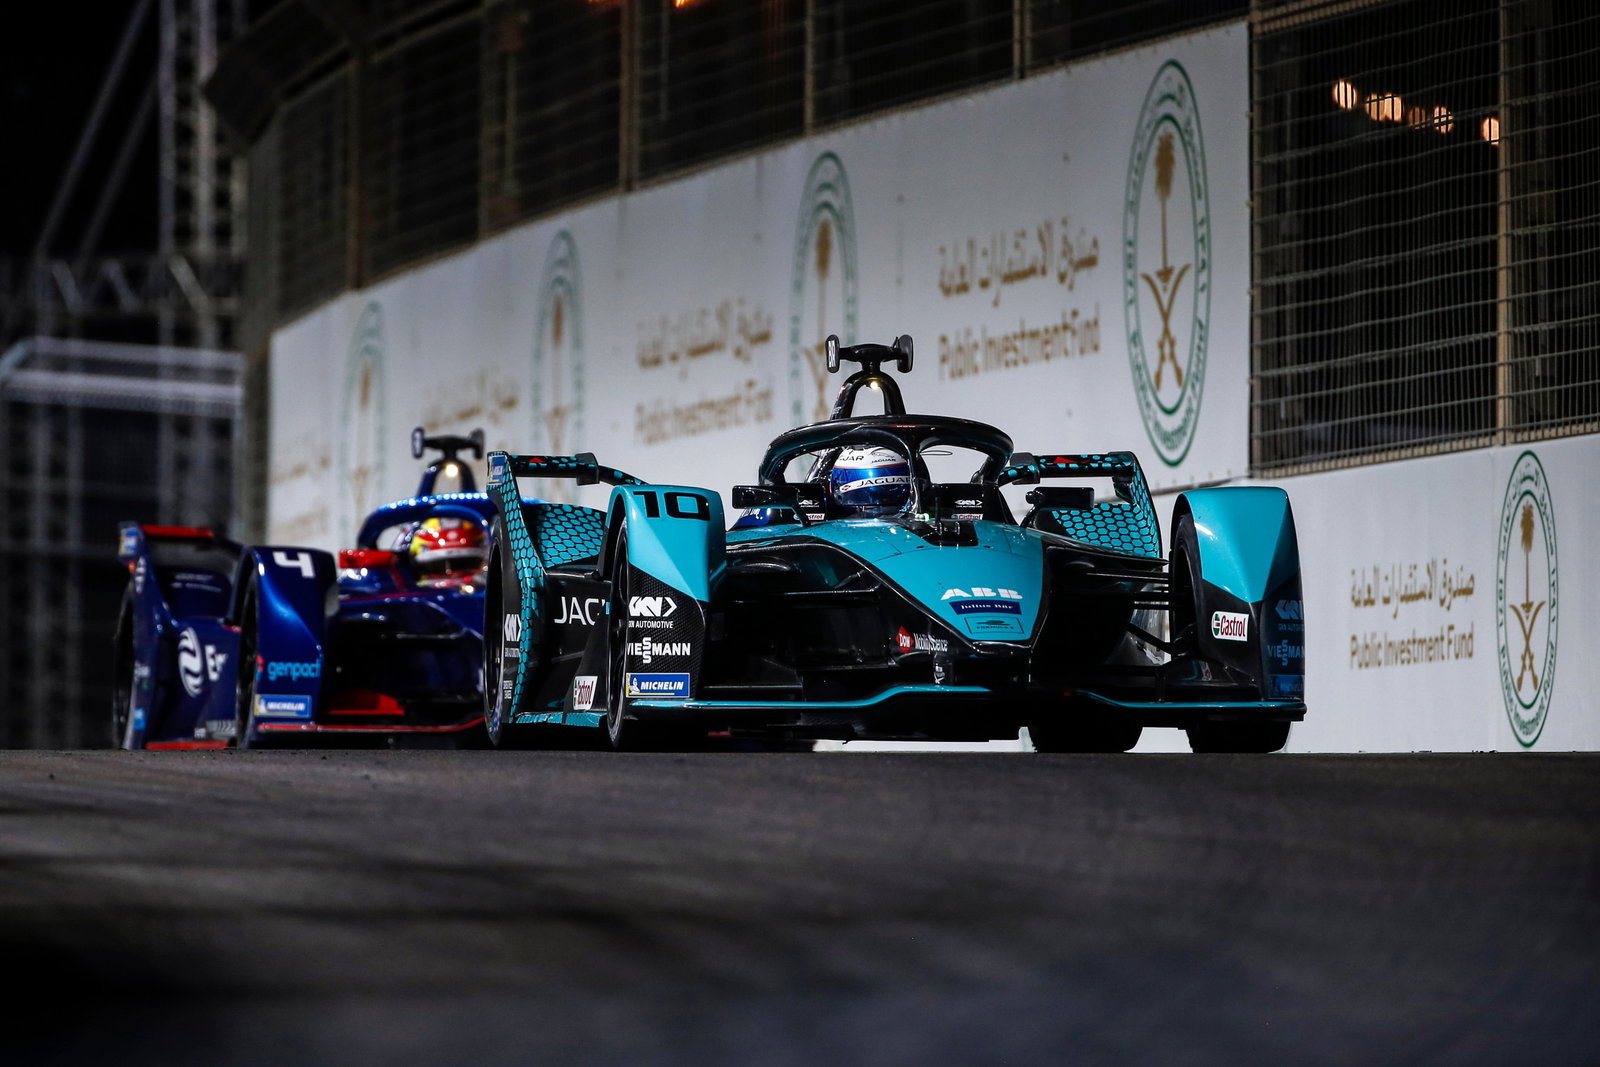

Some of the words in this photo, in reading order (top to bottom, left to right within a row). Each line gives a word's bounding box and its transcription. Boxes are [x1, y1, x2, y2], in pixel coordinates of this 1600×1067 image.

[937, 326, 980, 384] Public
[981, 310, 1070, 373] Investment
[1070, 303, 1100, 355] Fund
[633, 490, 710, 521] 10
[272, 550, 316, 579] 4
[941, 587, 1023, 601] ABB
[1350, 564, 1379, 608] العامة
[1381, 557, 1438, 620] الاستثمارات
[1439, 557, 1475, 613] صندوق
[635, 620, 674, 629] AUTOMOTIVE
[1220, 615, 1246, 637] Castrol
[1350, 632, 1383, 670] Public
[1383, 627, 1445, 667] Investment
[1446, 621, 1474, 661] Fund
[267, 657, 322, 682] genpact
[640, 681, 684, 691] MICHELIN
[266, 701, 306, 712] MICHELIN
